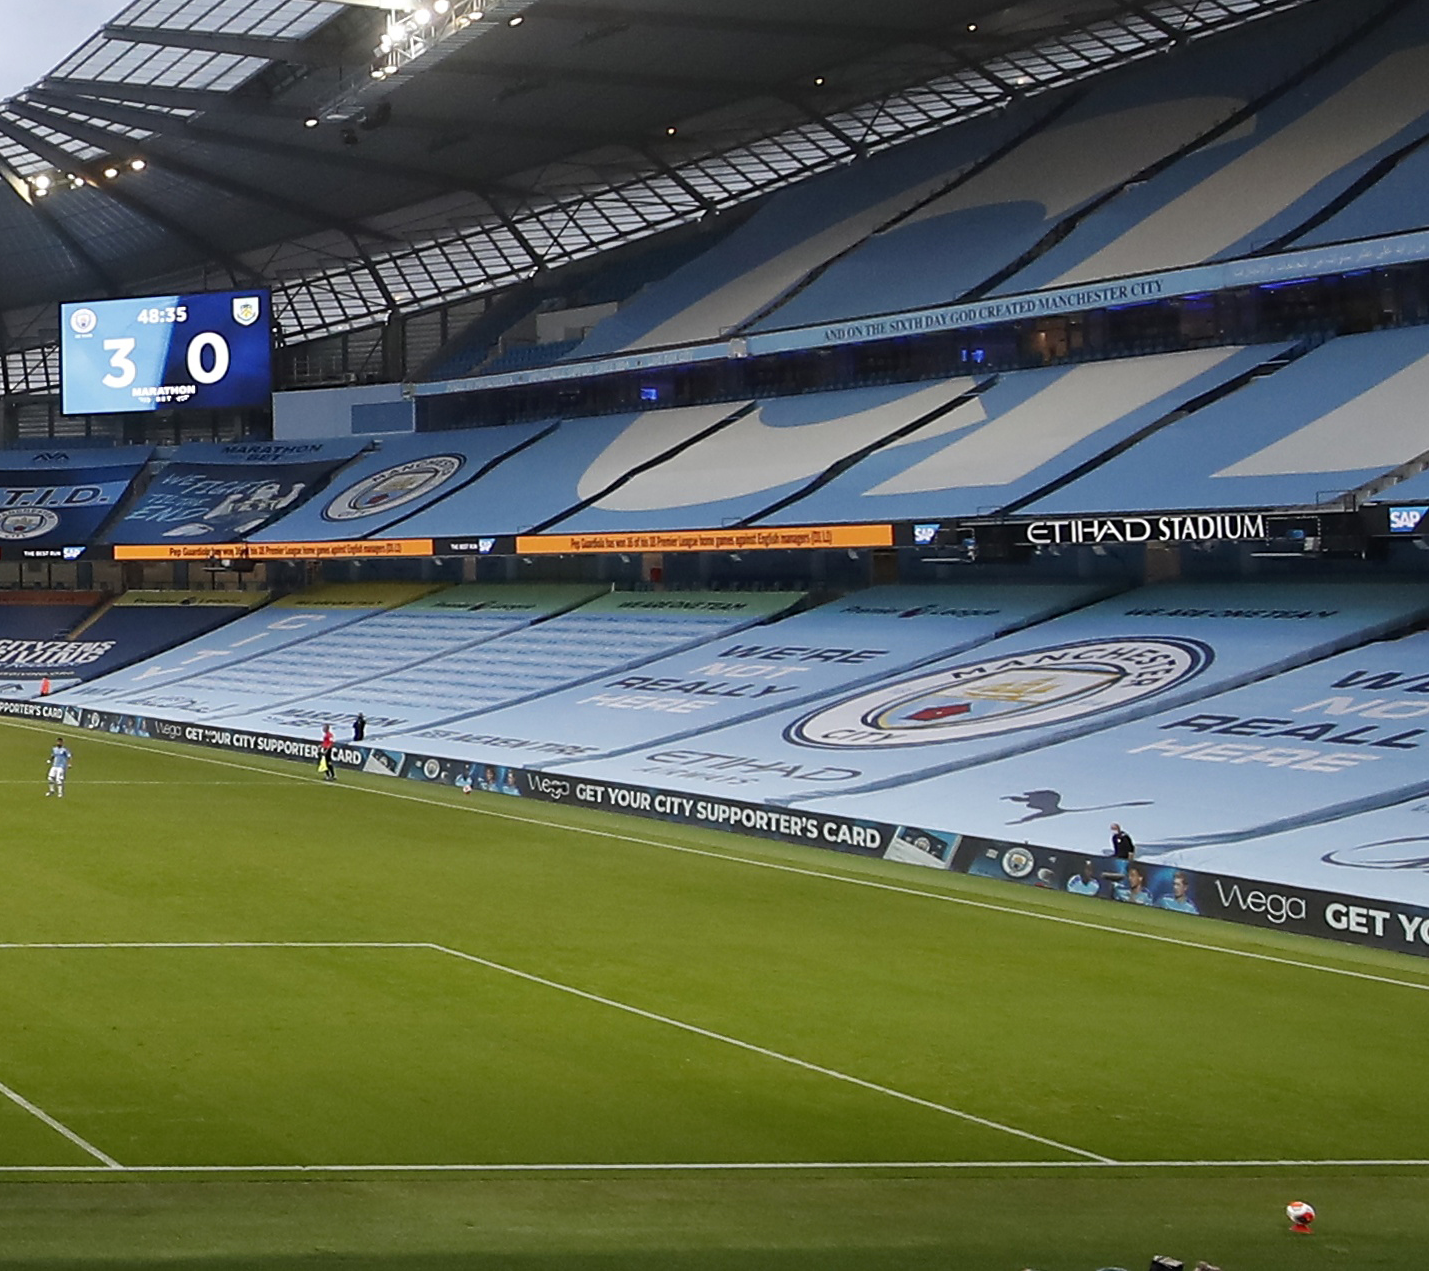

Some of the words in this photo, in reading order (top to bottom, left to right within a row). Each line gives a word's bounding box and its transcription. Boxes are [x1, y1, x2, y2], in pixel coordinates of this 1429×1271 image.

[137, 306, 187, 324] 48:35
[823, 329, 845, 342] AND
[847, 327, 863, 338] ON
[865, 324, 886, 336] THE
[889, 317, 923, 332] SIXTH
[925, 314, 948, 328] DAY
[950, 309, 976, 323] GOD
[978, 301, 1036, 320] CREATED
[1039, 286, 1129, 315] MANCHESTER
[1131, 279, 1164, 297] CITY
[102, 337, 137, 388] 3
[187, 331, 229, 384] 0
[132, 385, 195, 397] MARATHON
[221, 444, 323, 454] MARATHON
[246, 453, 283, 461] BET
[162, 474, 207, 486] WE
[124, 505, 211, 522] END
[1390, 511, 1420, 528] SAP
[915, 527, 934, 541] SAP
[1027, 519, 1151, 544] ETIHAD
[1159, 514, 1265, 541] STADIUM
[64, 547, 81, 559] SAP
[717, 644, 890, 664] WE'RE
[689, 661, 812, 680] NOT
[951, 646, 1177, 690] MANCHESTER
[604, 676, 800, 699] REALLY
[42, 707, 63, 719] CARD
[576, 693, 720, 714] HERE
[821, 728, 907, 743] CITY
[185, 727, 203, 742] GET
[205, 729, 231, 747] YOUR
[233, 733, 255, 750] CITY
[331, 747, 362, 766] CARD
[1127, 738, 1383, 773] HERE
[646, 750, 862, 780] ETIHAD
[576, 783, 605, 803] GET
[607, 787, 652, 812] YOUR
[655, 794, 694, 818] CITY
[696, 800, 819, 840] SUPPORTER'S
[823, 824, 881, 850] CARD
[1214, 880, 1307, 924] Wega
[1325, 902, 1391, 937] GET
